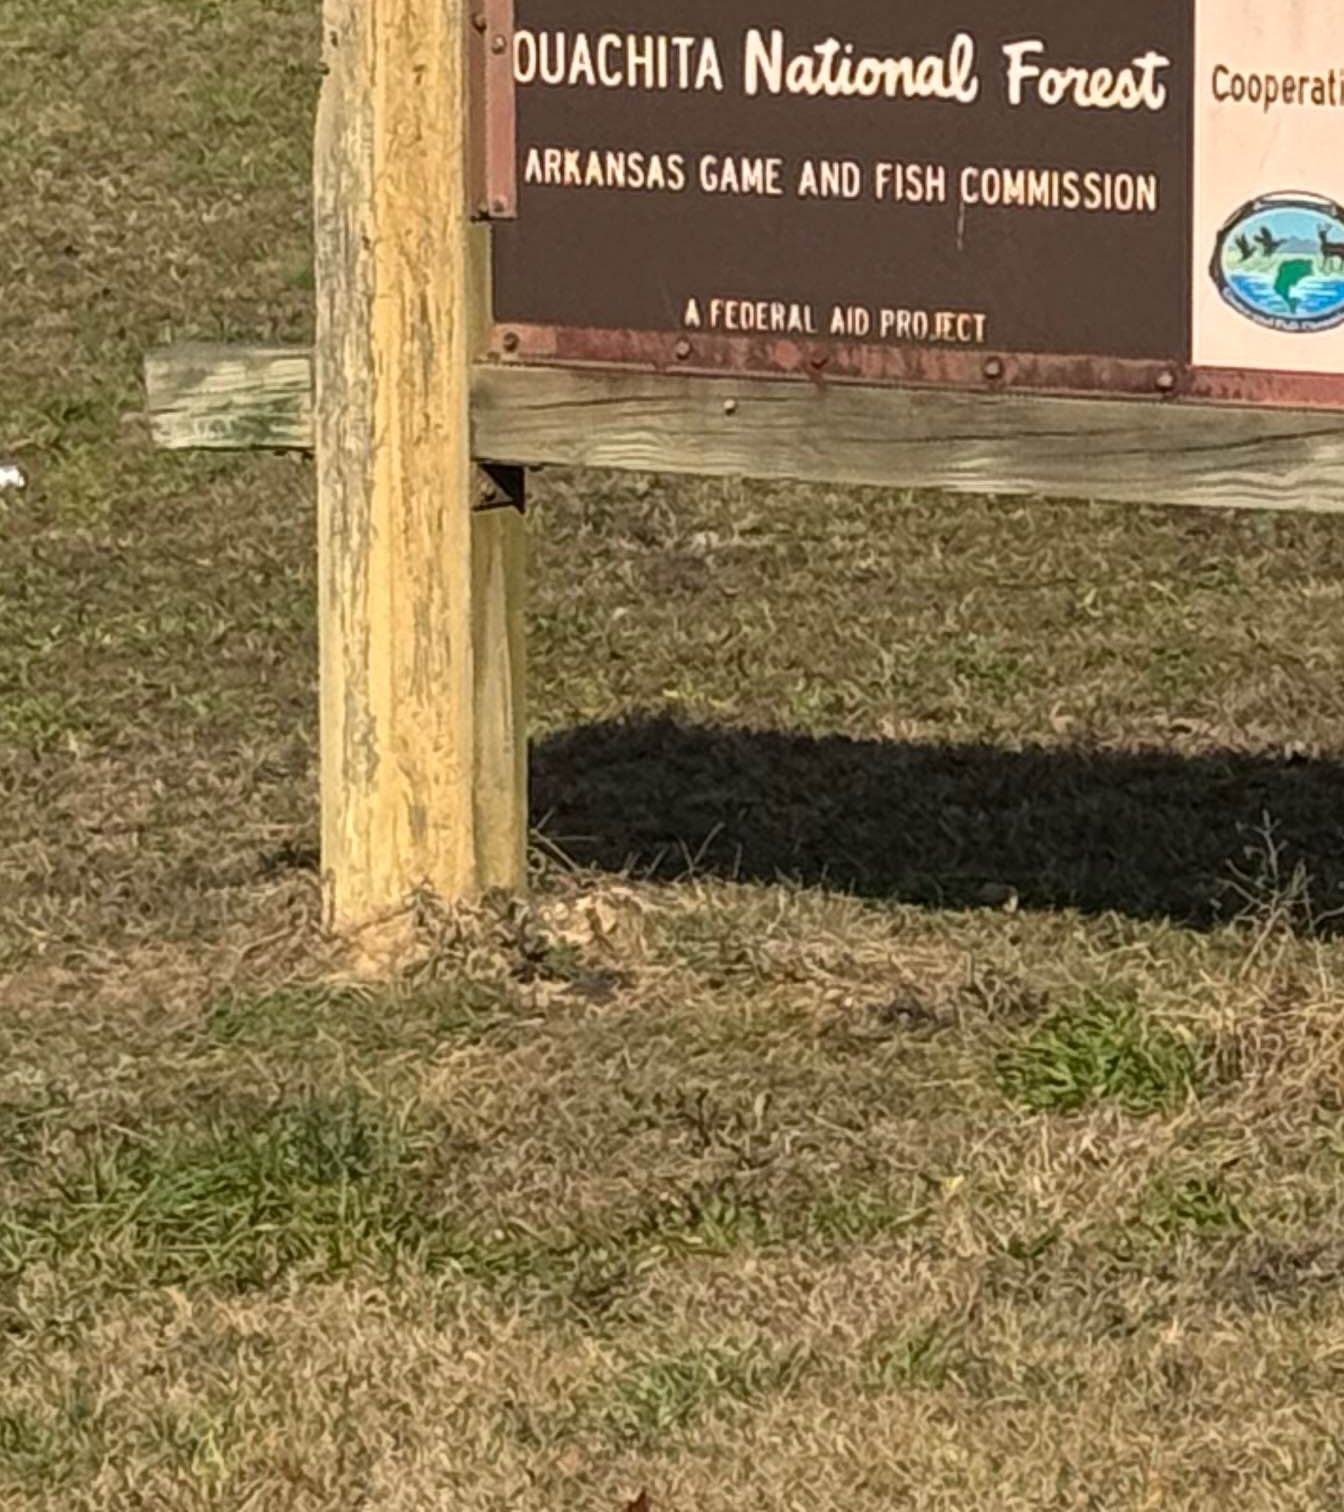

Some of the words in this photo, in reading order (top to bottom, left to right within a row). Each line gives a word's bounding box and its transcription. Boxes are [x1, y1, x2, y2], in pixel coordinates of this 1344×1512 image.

[512, 29, 723, 91] OUACHITA
[743, 29, 979, 105] National
[1002, 40, 1171, 110] Forest
[524, 148, 685, 191] ARKANSAS
[699, 154, 783, 196] GAME
[798, 160, 861, 198] AND
[875, 162, 946, 202] FISH
[960, 166, 1157, 211] COMMISSION
[684, 298, 701, 327] A
[710, 298, 816, 333] FEDERAL
[829, 305, 870, 336] AID
[879, 308, 987, 343] PROJECT
